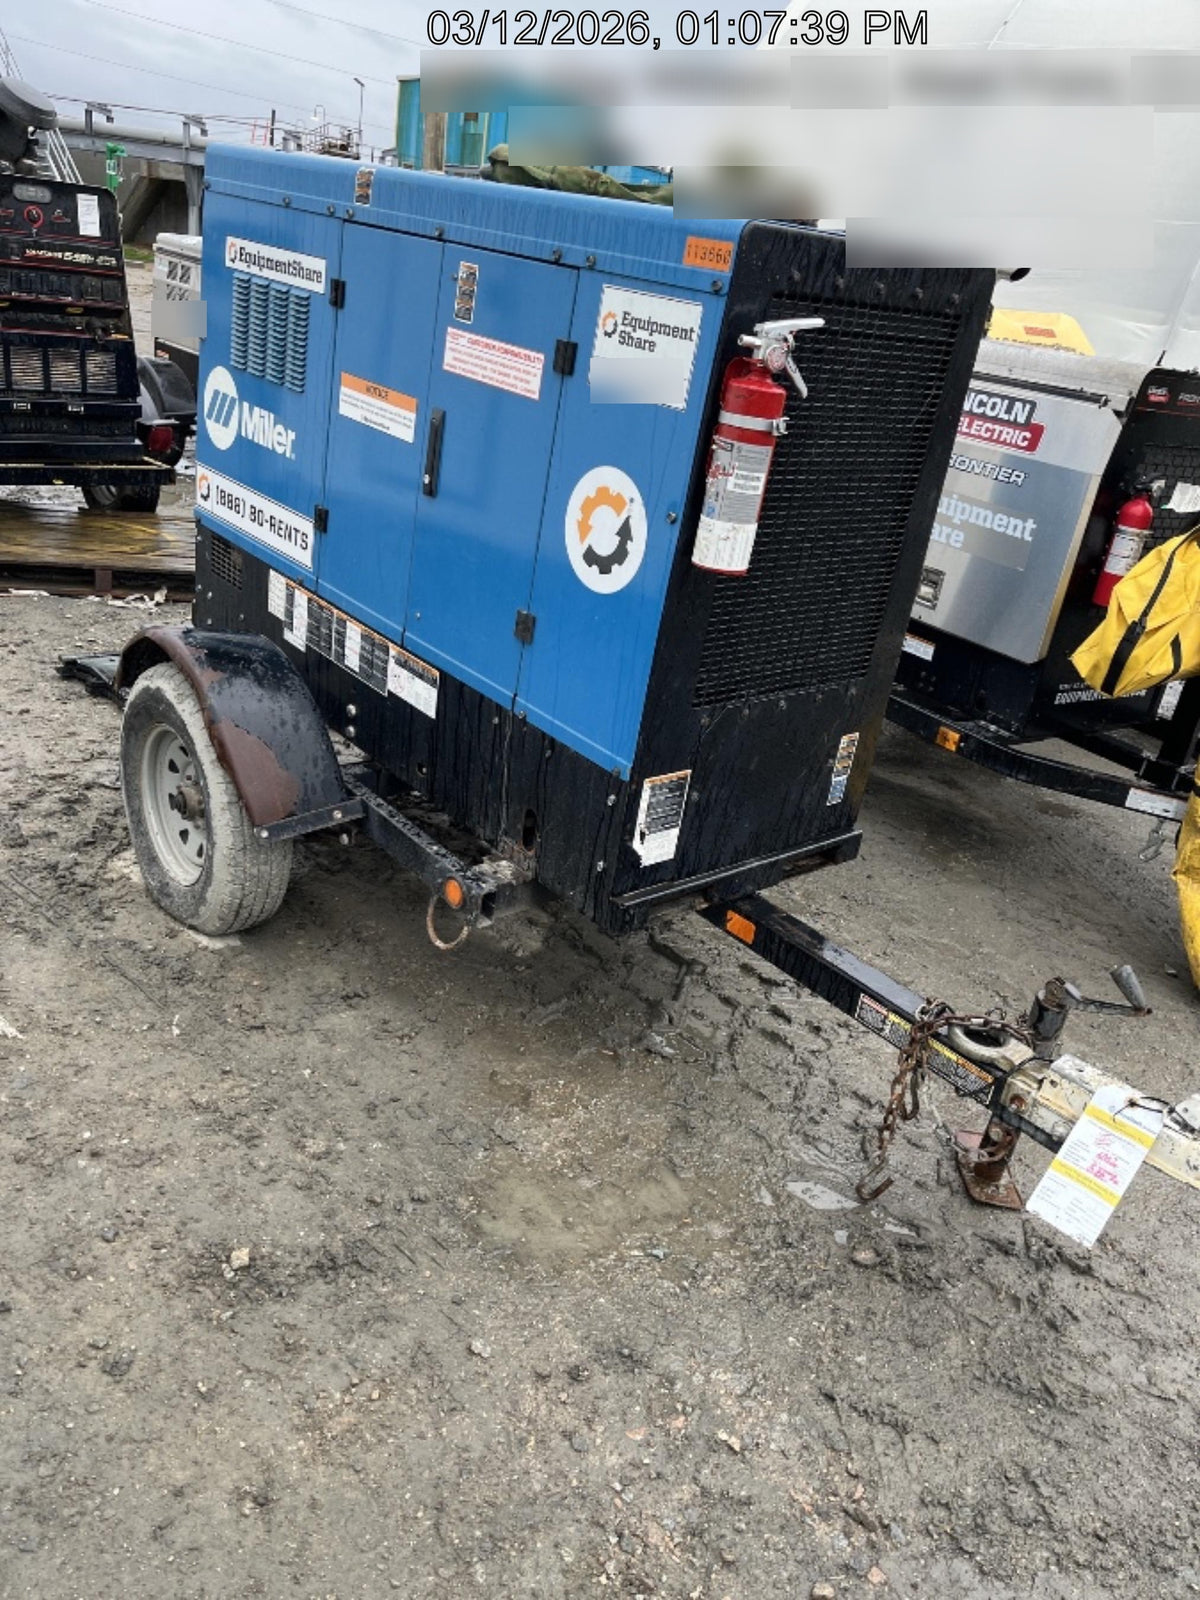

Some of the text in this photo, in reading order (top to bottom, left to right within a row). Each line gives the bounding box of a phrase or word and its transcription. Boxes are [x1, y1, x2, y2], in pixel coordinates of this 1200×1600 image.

[239, 246, 323, 283] EquipmentShare
[618, 330, 657, 353] Share
[620, 310, 696, 342] Equipment
[241, 400, 296, 459] Miller
[215, 484, 309, 551] (888) 80-RENTS
